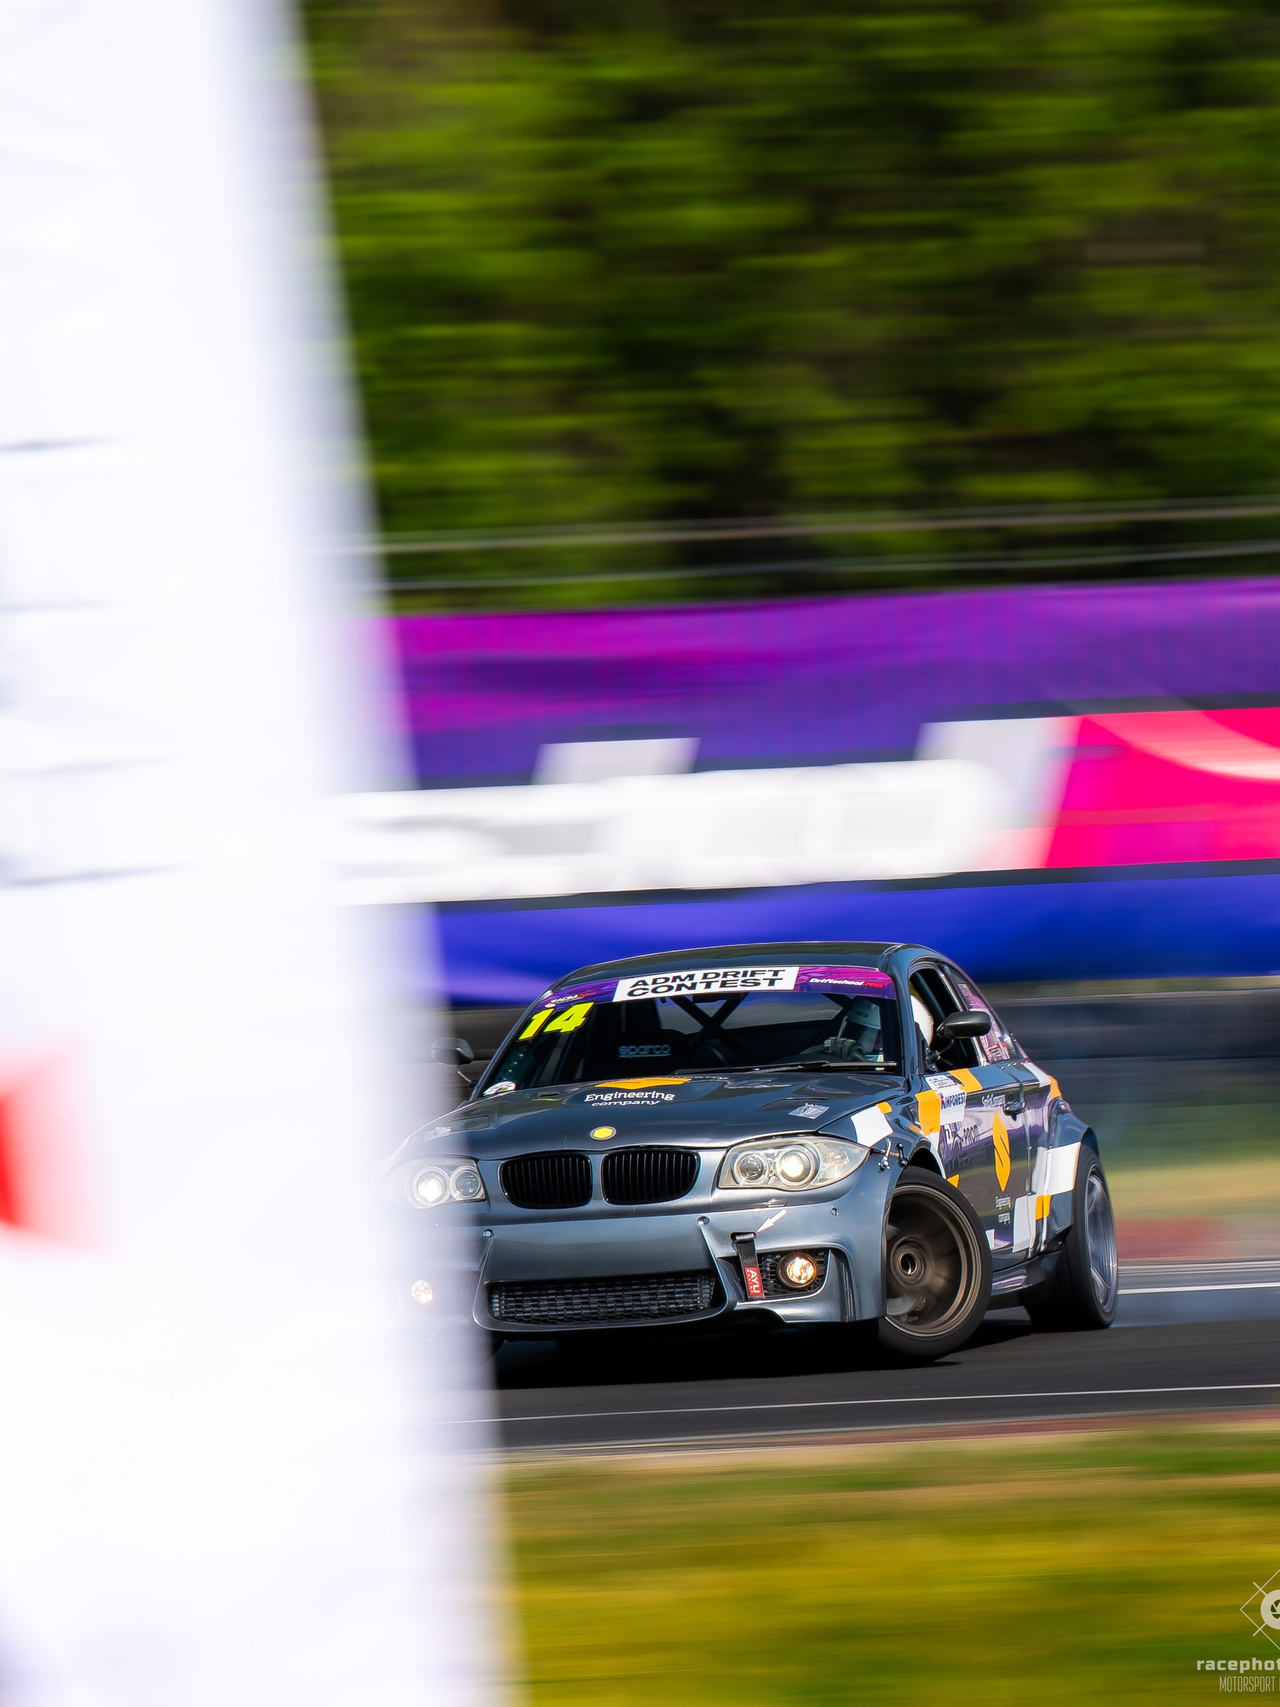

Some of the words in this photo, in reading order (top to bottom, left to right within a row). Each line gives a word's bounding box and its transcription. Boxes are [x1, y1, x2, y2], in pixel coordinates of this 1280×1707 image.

[626, 977, 783, 997] CONTEST
[629, 972, 697, 989] ADM
[701, 969, 786, 980] DRIFT
[517, 1001, 596, 1042] 14
[618, 1044, 671, 1059] sparco
[583, 1090, 676, 1103] Engineering
[591, 1099, 661, 1107] company
[749, 1269, 761, 1294] AYU
